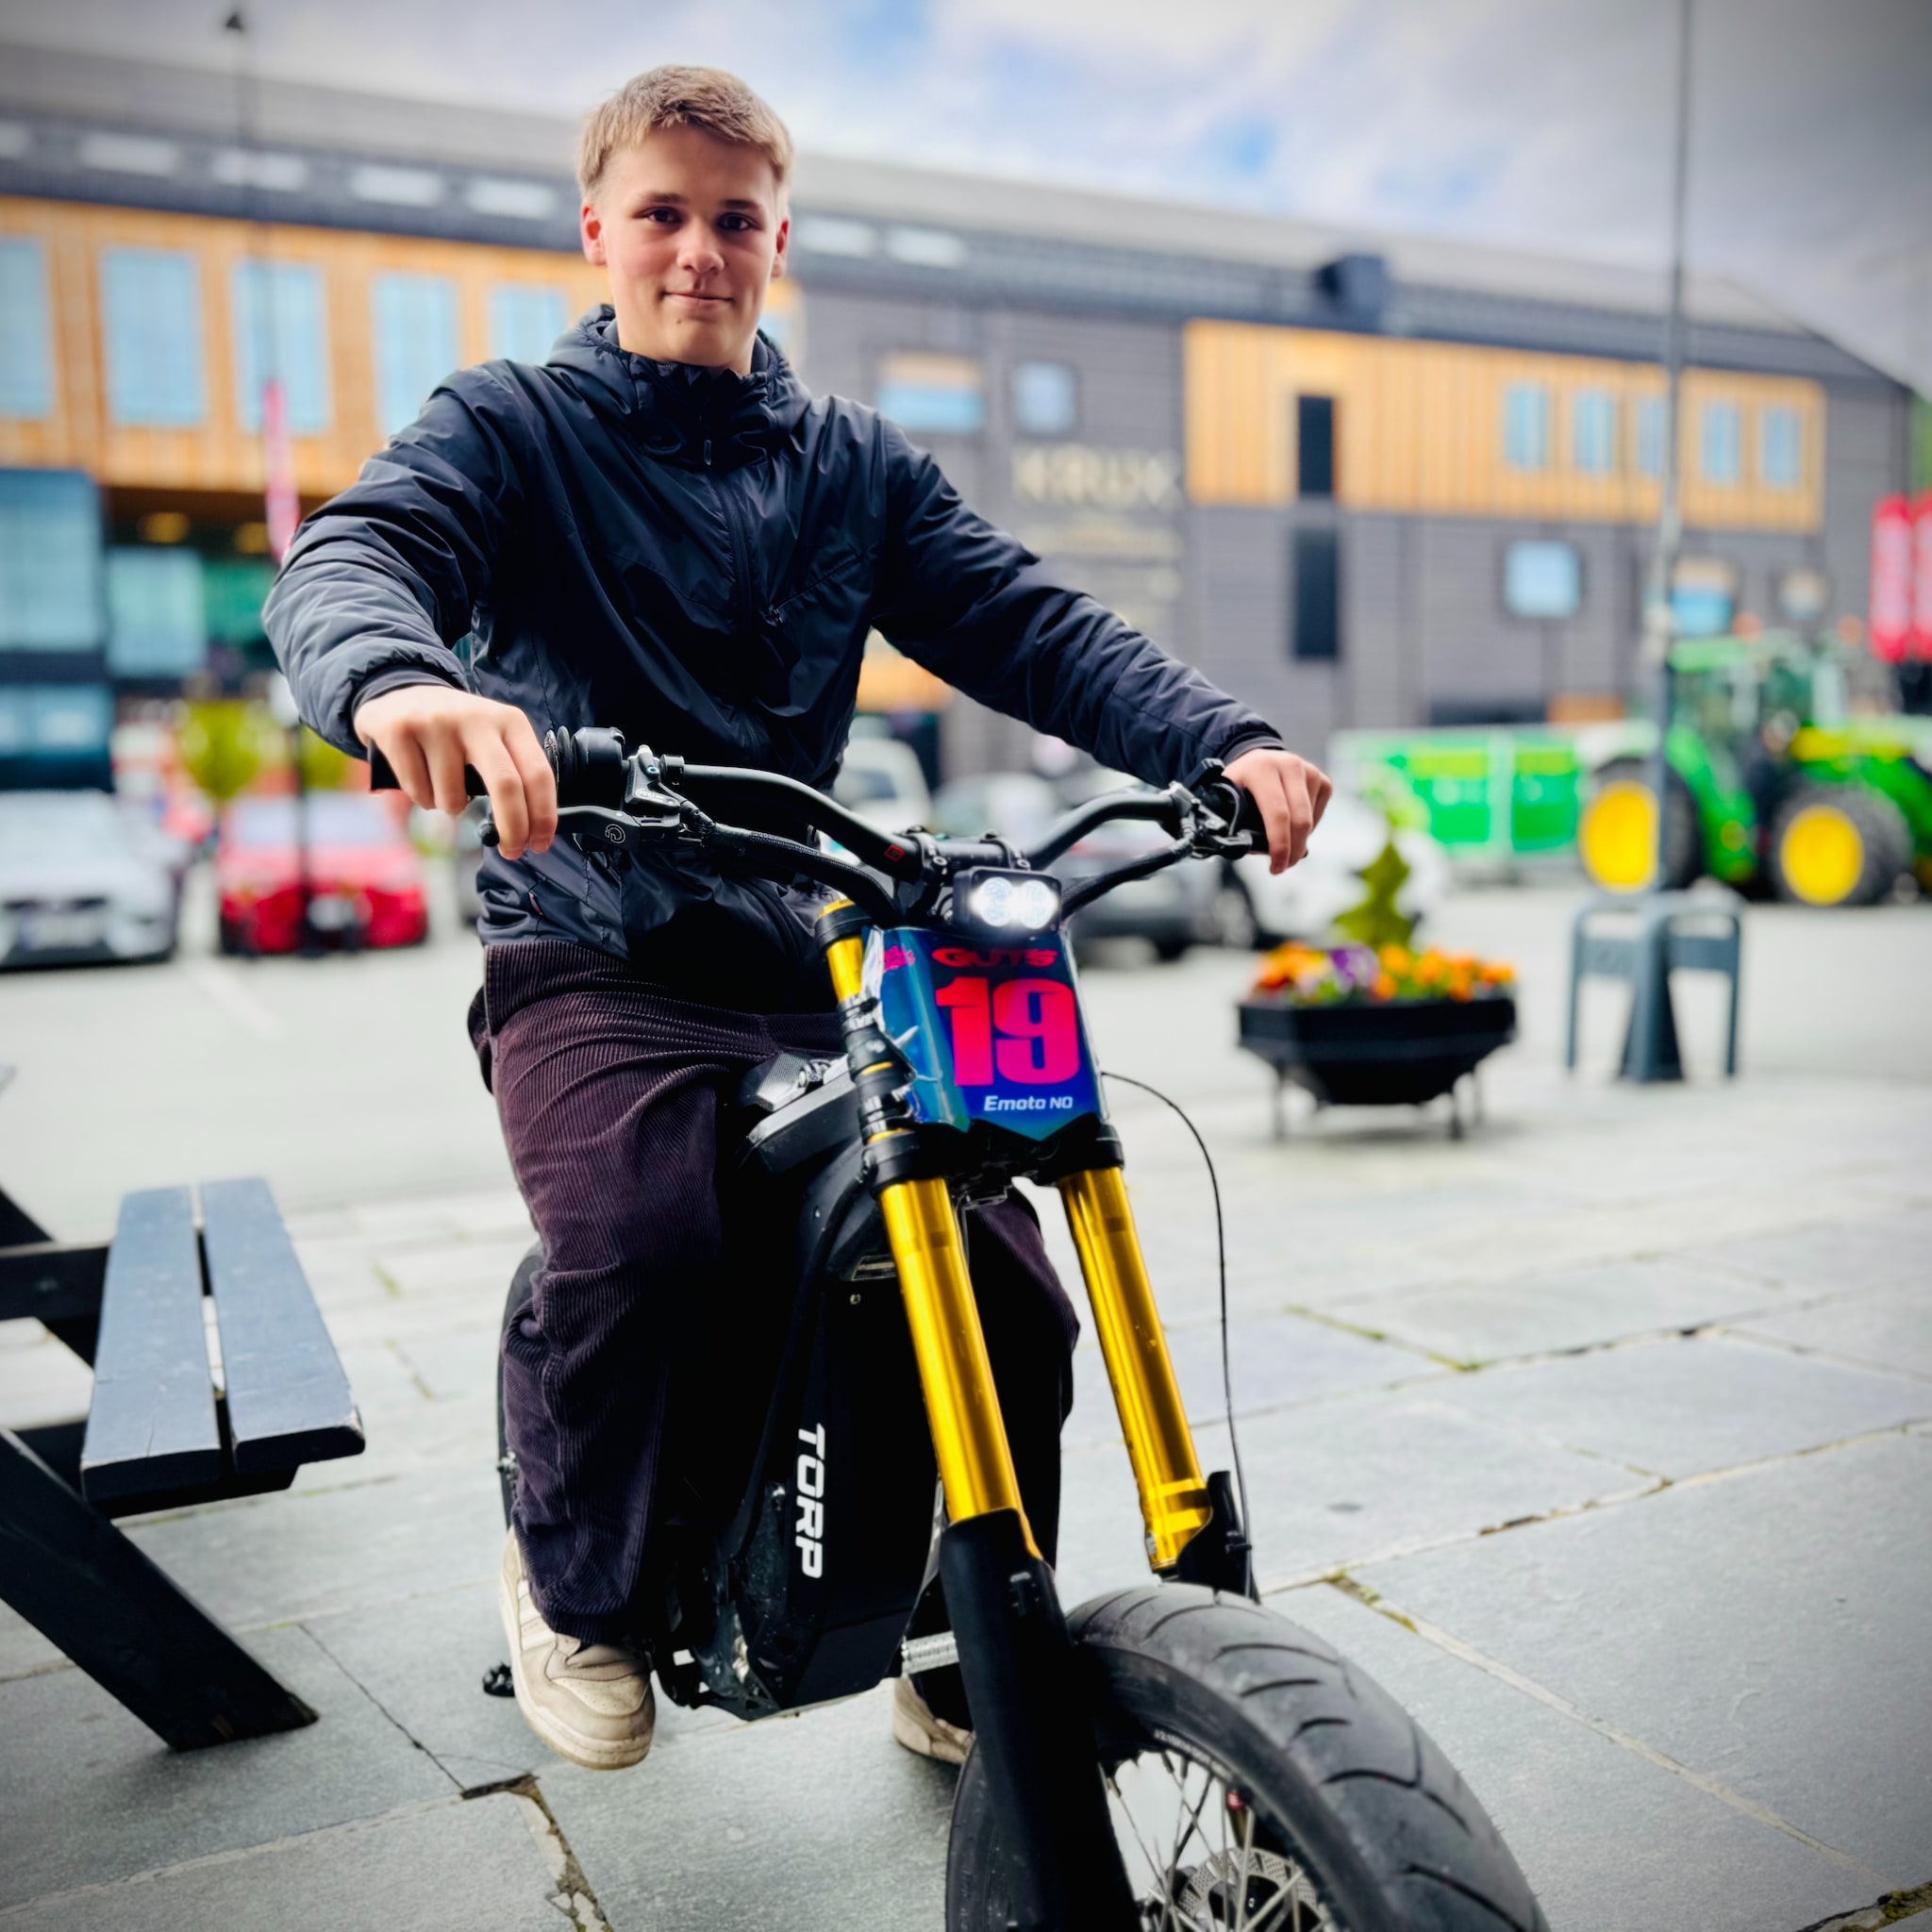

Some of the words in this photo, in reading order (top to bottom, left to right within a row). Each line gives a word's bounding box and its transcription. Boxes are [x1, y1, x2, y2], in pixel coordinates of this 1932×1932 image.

[931, 947, 1058, 967] GUTS
[935, 976, 1079, 1086] 19
[984, 1095, 1046, 1111] Emoto
[1049, 1096, 1074, 1109] NO
[795, 1423, 825, 1578] TORP
